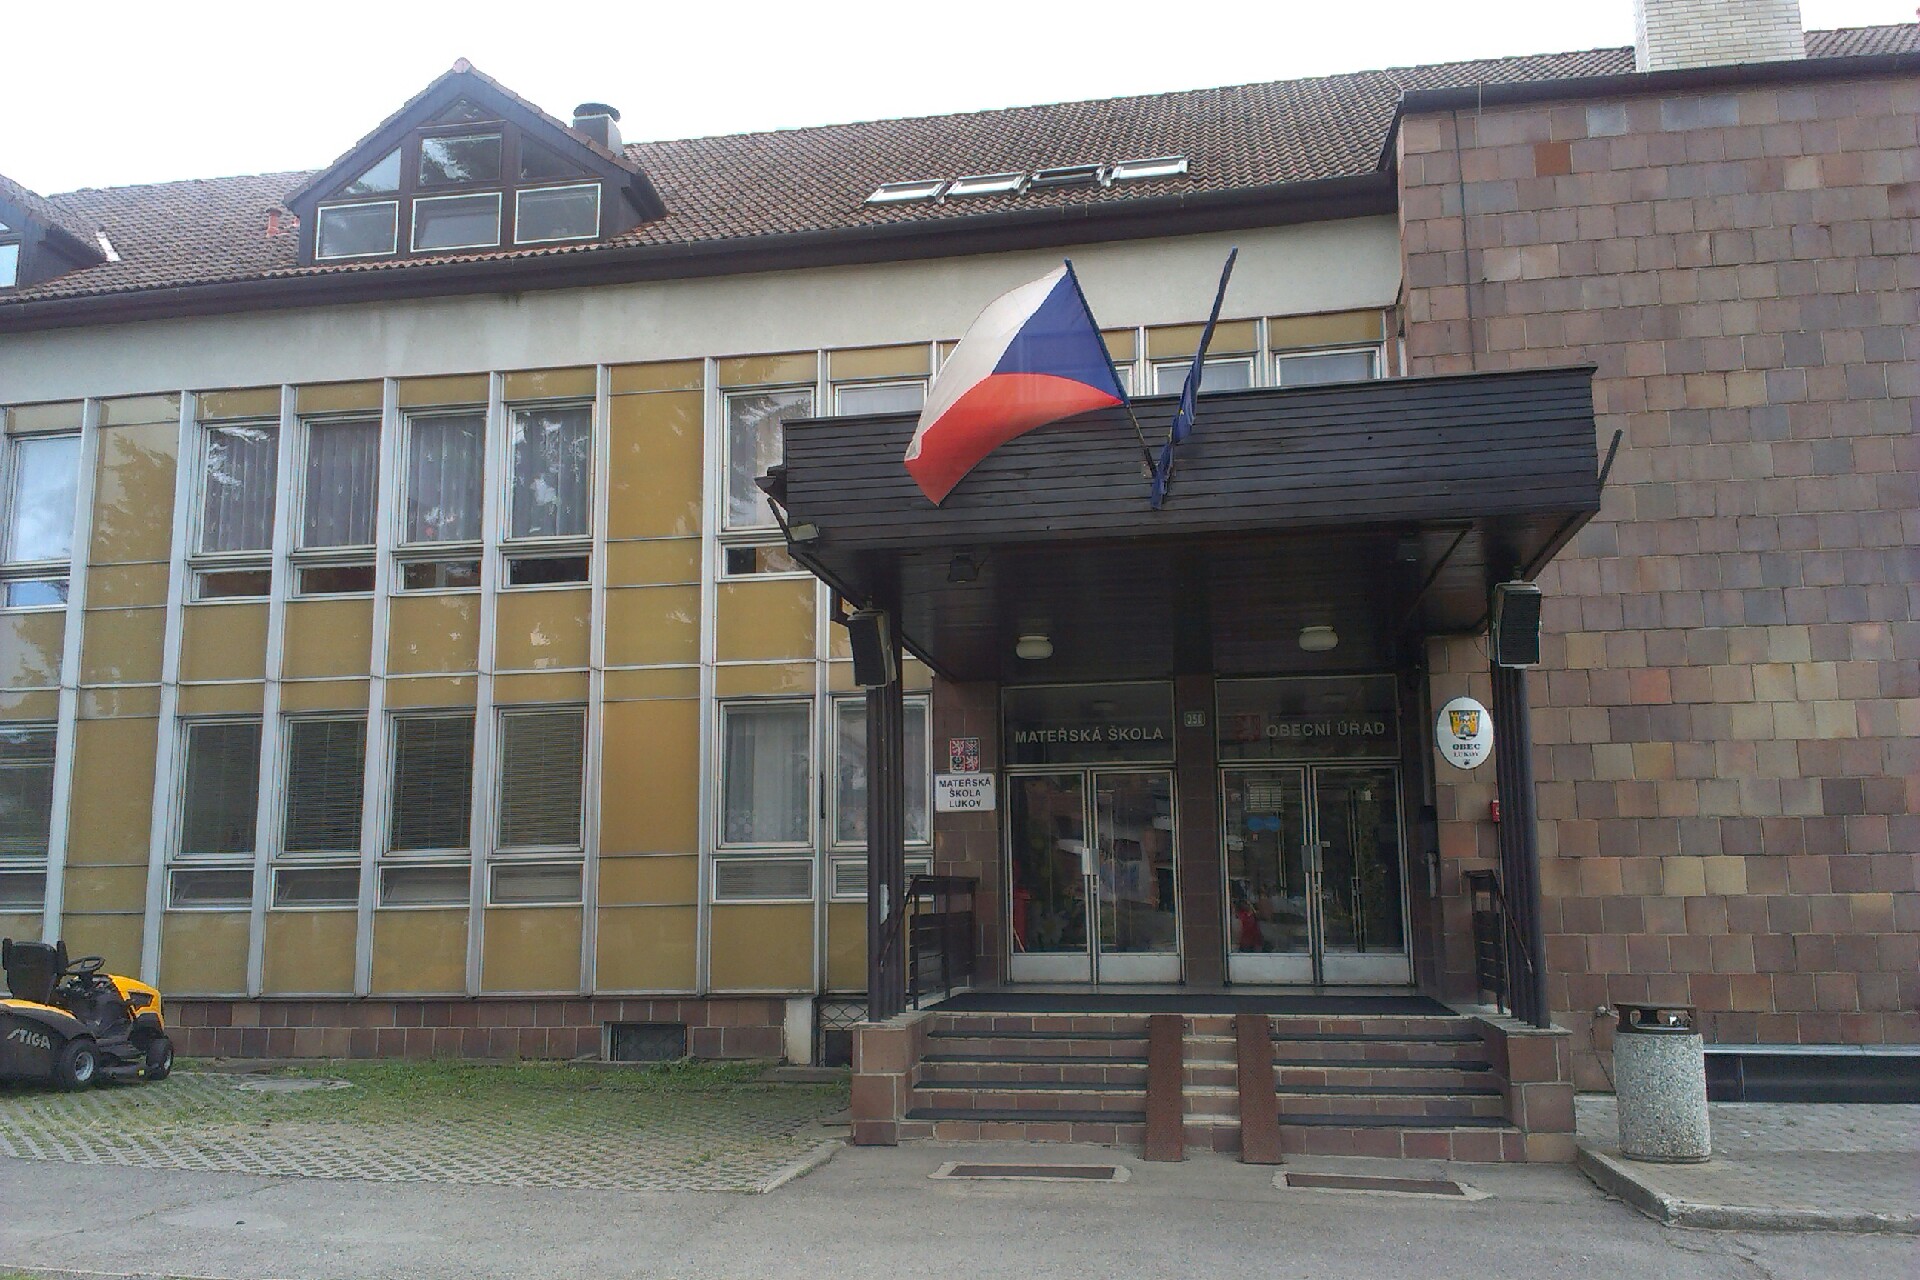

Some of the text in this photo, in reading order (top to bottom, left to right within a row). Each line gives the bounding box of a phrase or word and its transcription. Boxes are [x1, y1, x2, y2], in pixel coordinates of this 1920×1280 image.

[1015, 725, 1164, 743] MATEŘSKÁ ŠKOLA
[1265, 720, 1386, 737] OBECNÍ ÚŘAD
[1452, 743, 1481, 751] OBEC
[938, 777, 991, 788] MATEŘSKÁ
[949, 788, 981, 798] ŠKOLA
[949, 799, 982, 808] LUKOV
[6, 1028, 51, 1050] STIGA
